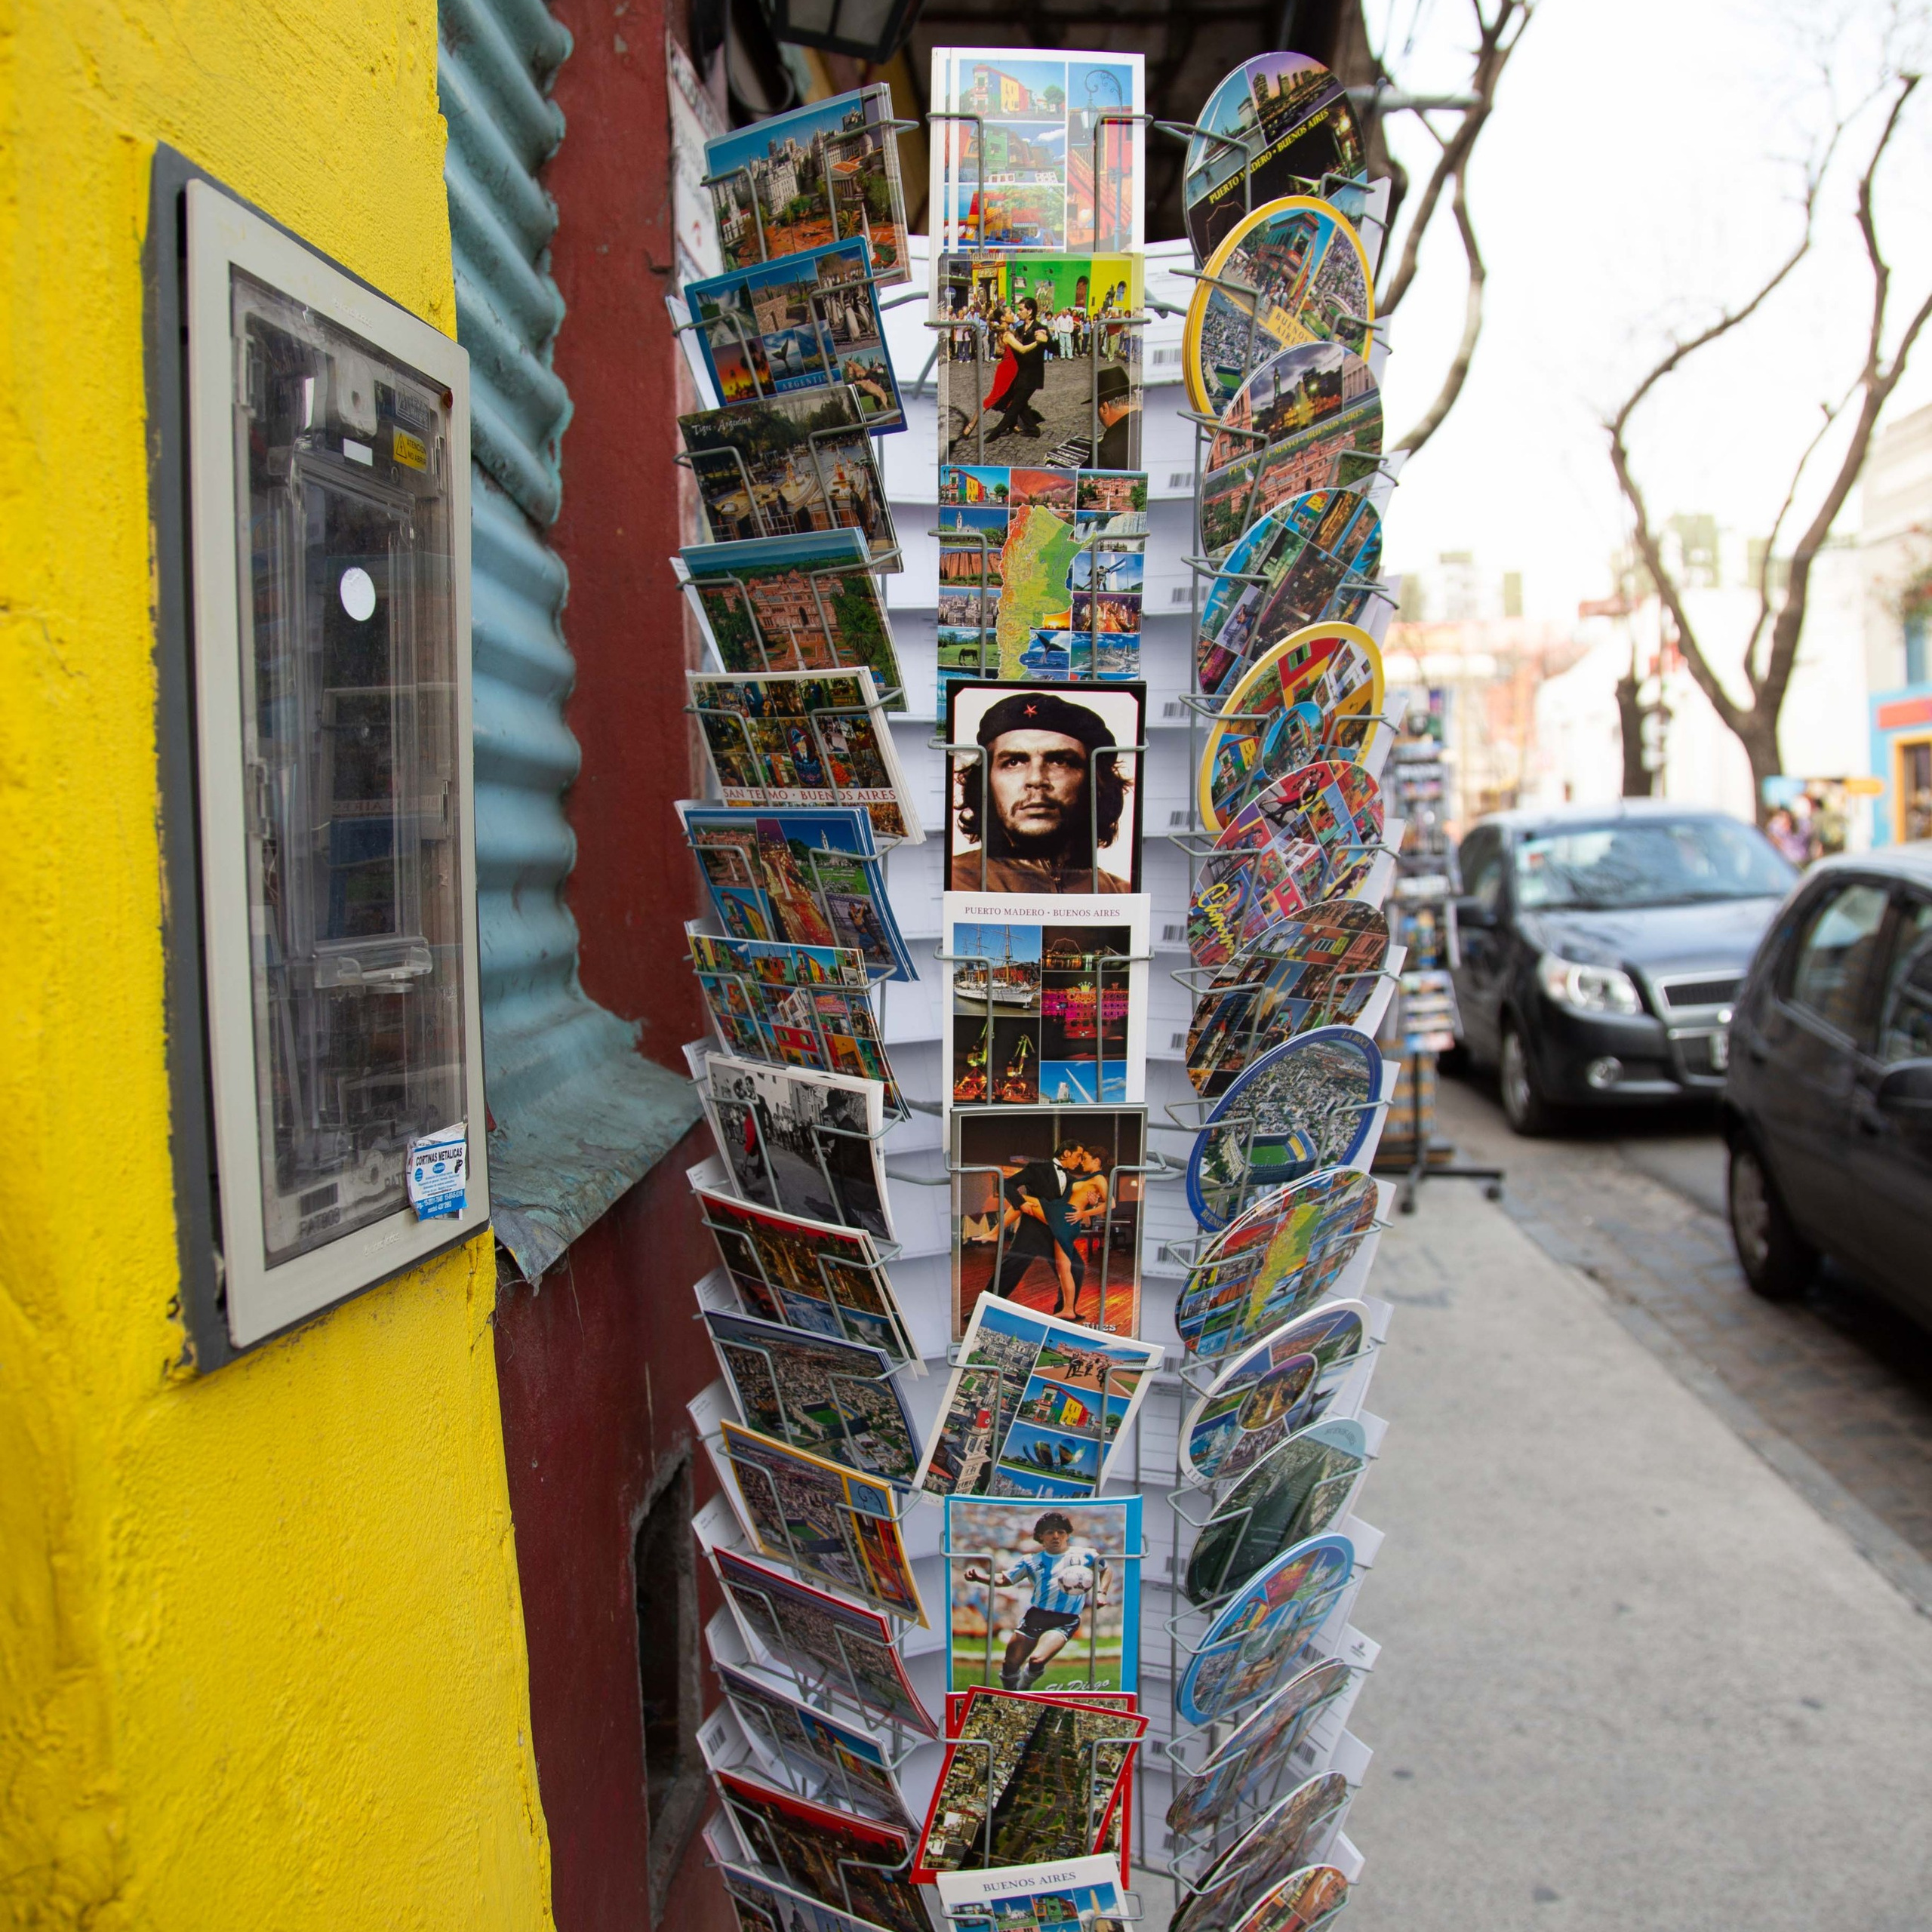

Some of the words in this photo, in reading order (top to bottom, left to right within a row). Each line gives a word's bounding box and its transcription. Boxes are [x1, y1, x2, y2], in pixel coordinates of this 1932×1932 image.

[1208, 175, 1239, 205] PUERTO
[1275, 124, 1307, 152] BUENOS
[1306, 108, 1330, 130] AIRES
[1275, 325, 1299, 345] AIRE
[718, 417, 752, 432] Argentina
[1306, 420, 1340, 440] BUENOS
[723, 788, 745, 798] SAN
[857, 789, 897, 801] AIRES
[964, 906, 1001, 915] PUERTO
[1004, 908, 1045, 917] MADERO
[1053, 908, 1091, 917] BUENOS
[1094, 909, 1121, 918] AIRES
[416, 1152, 438, 1167] CORTINAS
[438, 1147, 463, 1160] METALICAS
[1067, 1679, 1110, 1691] Digo
[982, 1877, 1035, 1892] BUENOS
[1038, 1872, 1077, 1885] AIRES
